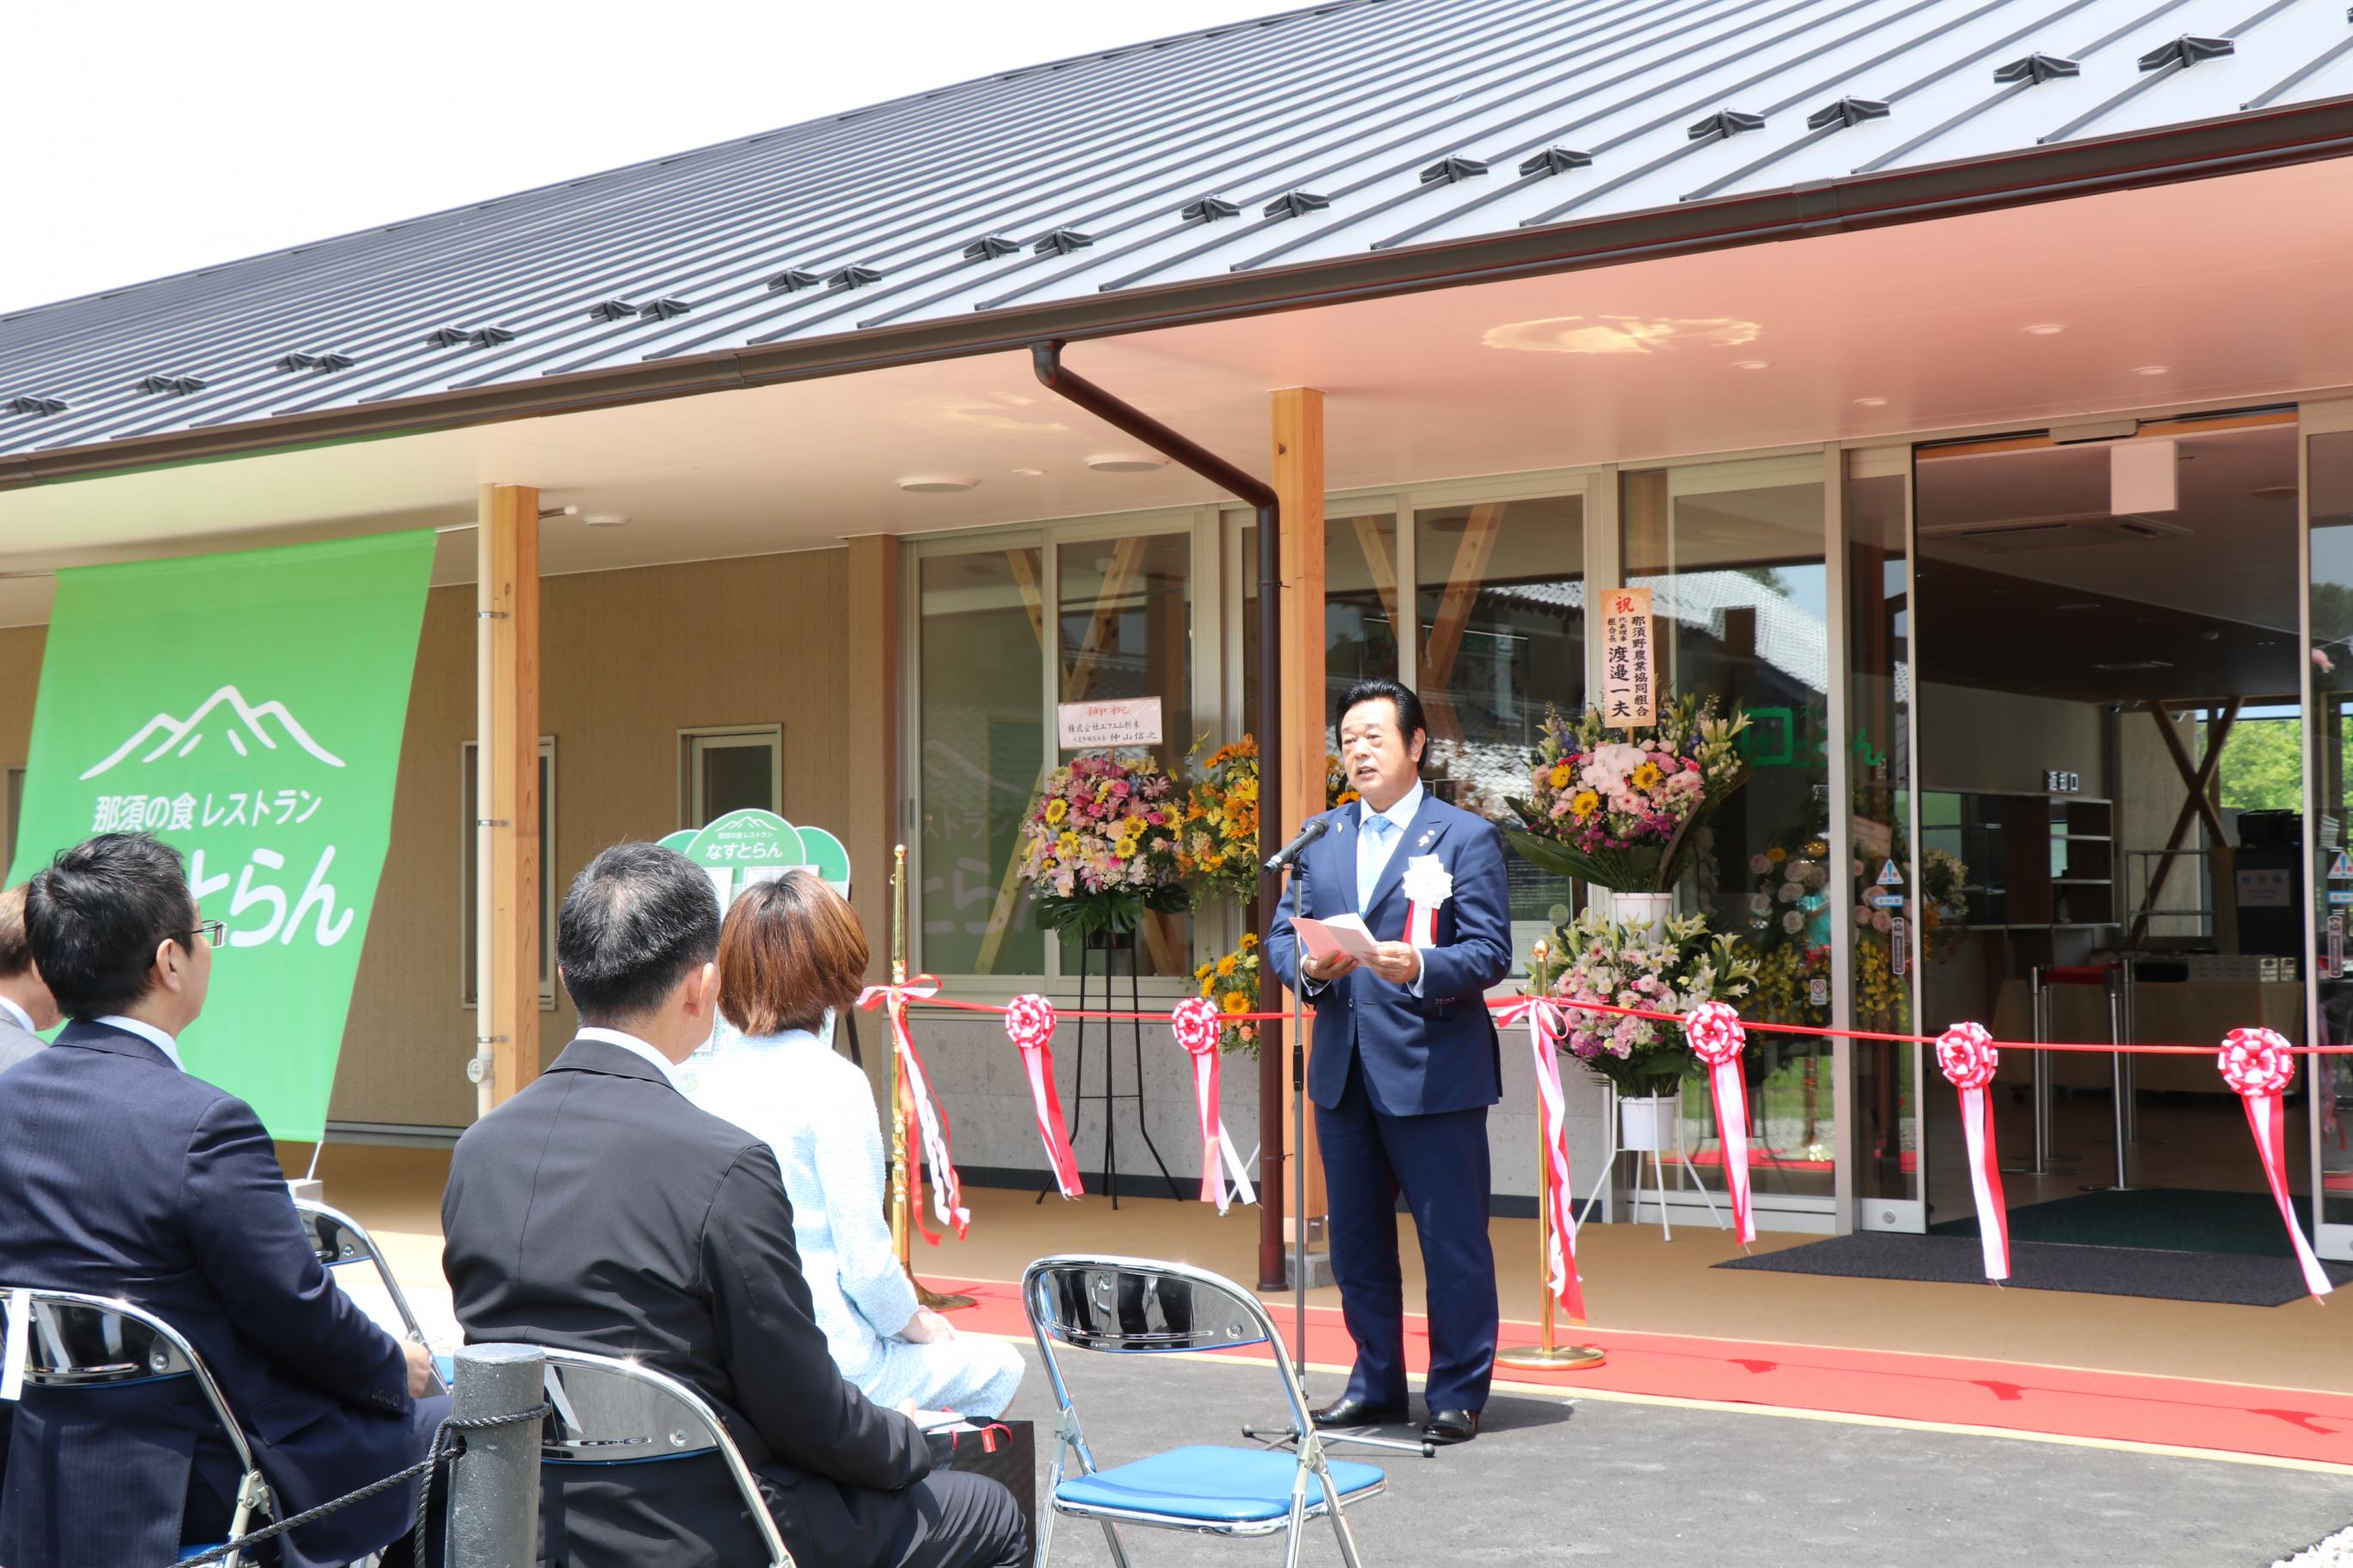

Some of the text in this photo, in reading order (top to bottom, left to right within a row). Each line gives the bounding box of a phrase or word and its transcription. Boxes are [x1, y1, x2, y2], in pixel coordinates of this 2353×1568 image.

[1616, 596, 1634, 614] 祝
[1607, 617, 1616, 643] 組合長
[1631, 615, 1649, 717] 那須野農業協同組合
[1088, 706, 1130, 716] 御祝
[706, 842, 784, 860] なすとらん
